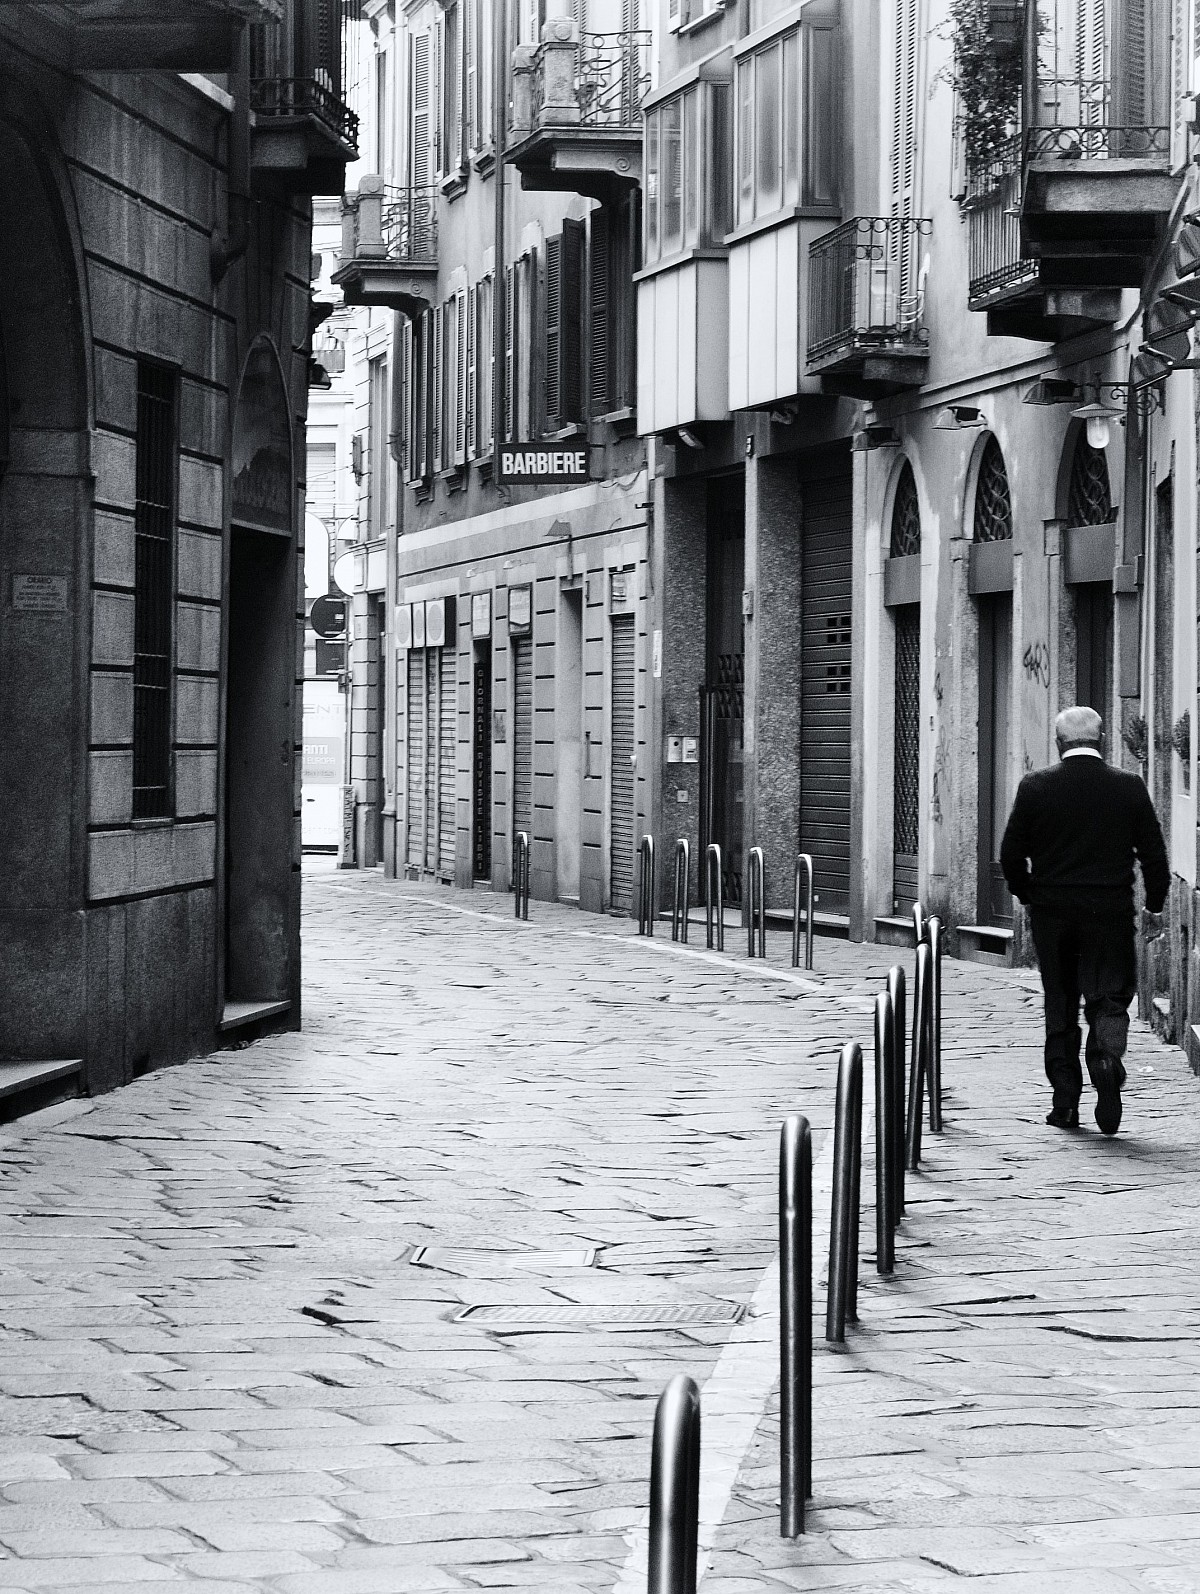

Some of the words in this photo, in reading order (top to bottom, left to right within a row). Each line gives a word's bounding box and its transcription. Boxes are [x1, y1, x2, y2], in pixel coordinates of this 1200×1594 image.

[502, 452, 586, 475] BARBIERE
[476, 669, 485, 742] GIORNALI
[476, 752, 484, 816] RIVISTE
[476, 825, 484, 871] LIBRI
